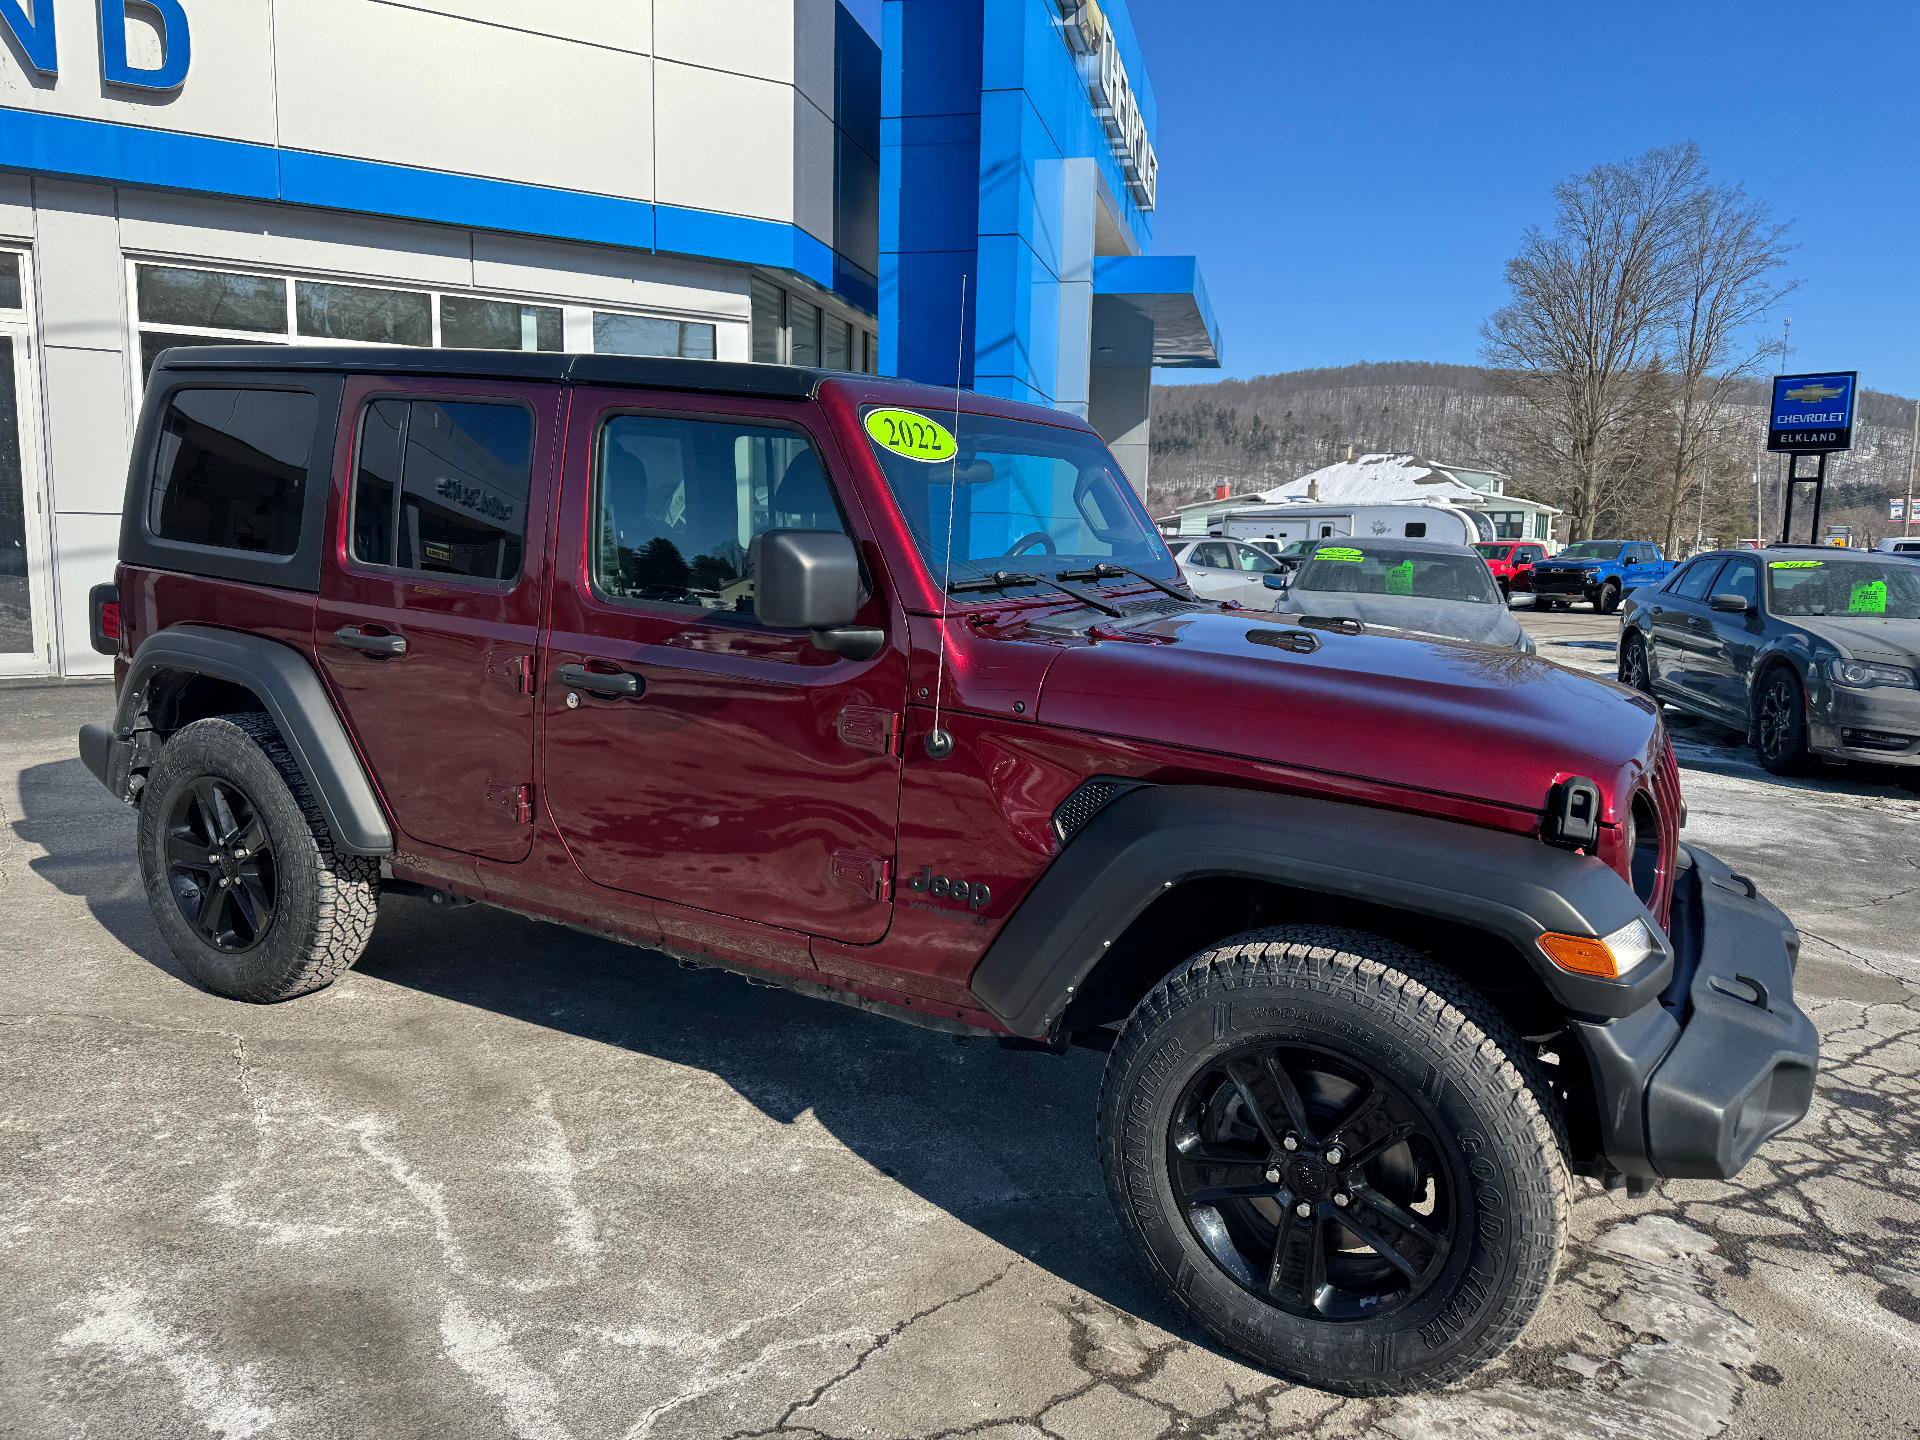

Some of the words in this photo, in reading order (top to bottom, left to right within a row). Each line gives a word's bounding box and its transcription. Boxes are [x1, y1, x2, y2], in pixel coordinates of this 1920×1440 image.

[883, 417, 942, 451] 2022
[1777, 412, 1844, 424] CHEVROLET
[1780, 432, 1836, 443] ELKLAND
[910, 865, 991, 911] Jeep
[1126, 1036, 1188, 1234] WRANGLER
